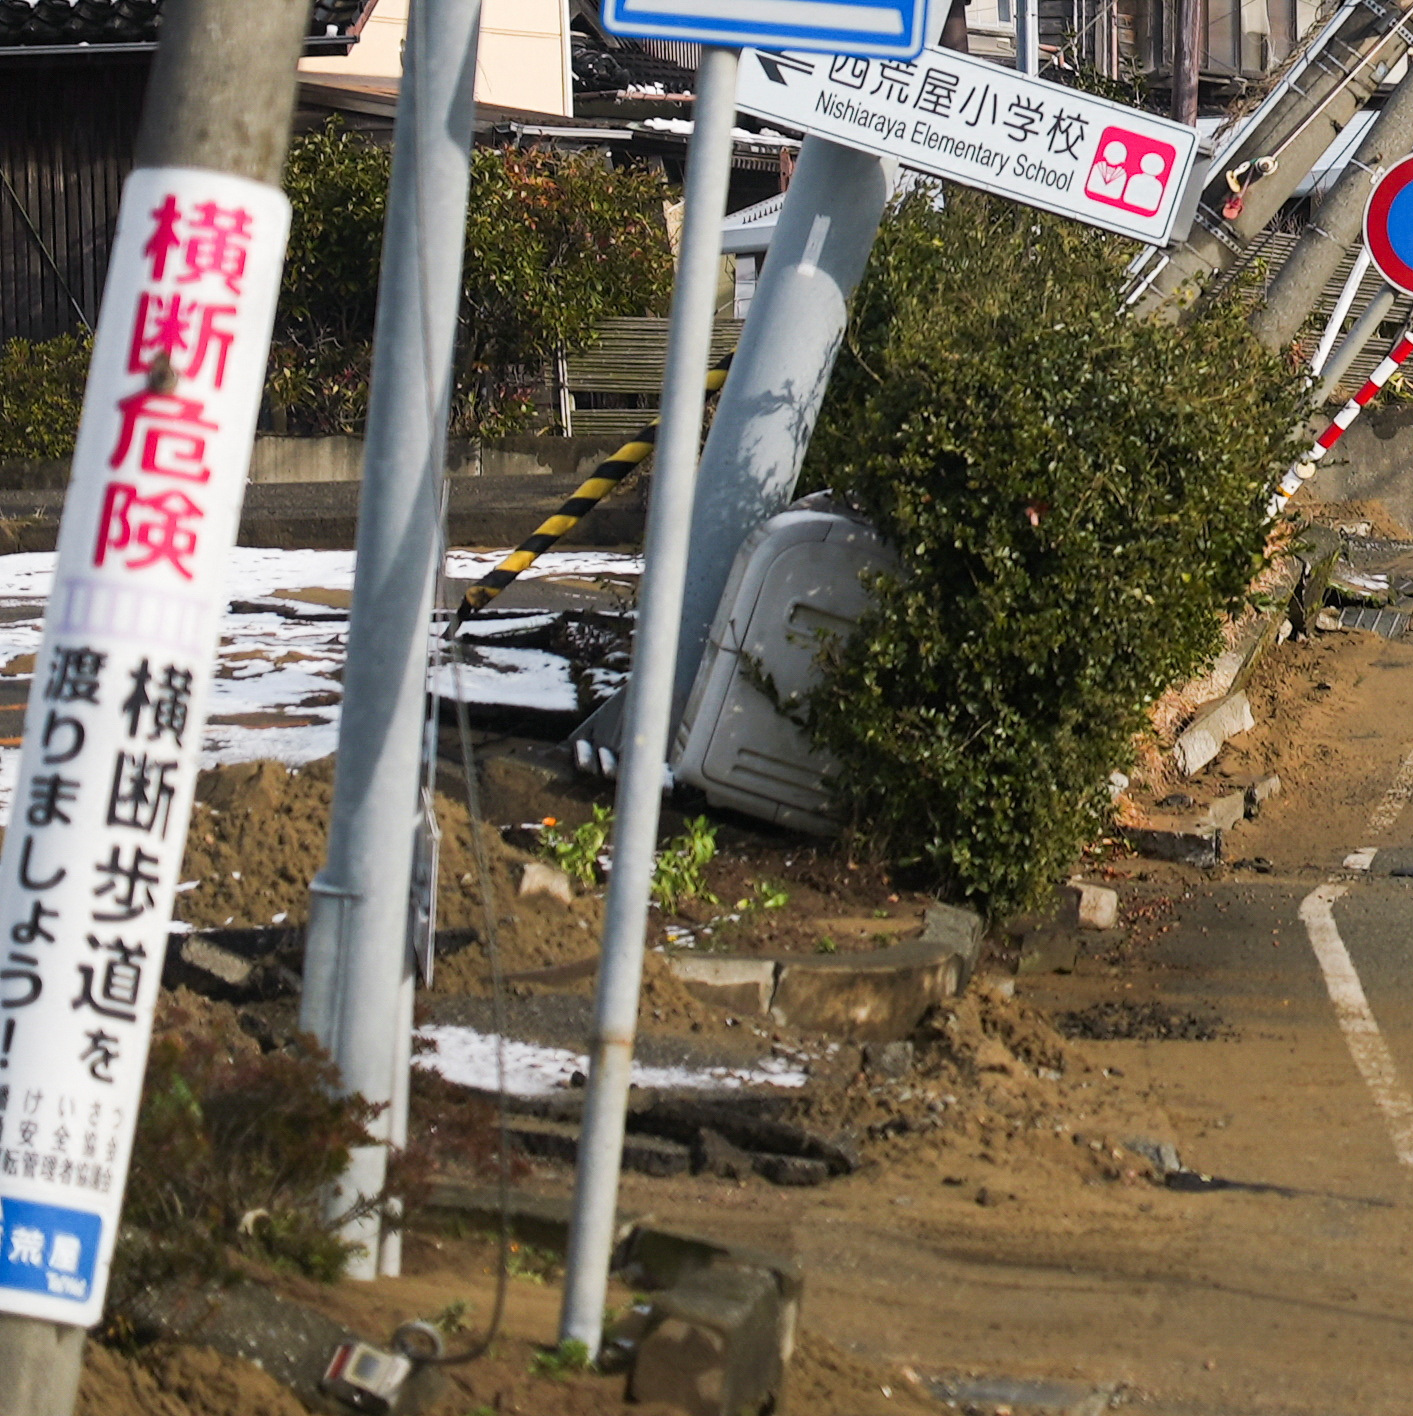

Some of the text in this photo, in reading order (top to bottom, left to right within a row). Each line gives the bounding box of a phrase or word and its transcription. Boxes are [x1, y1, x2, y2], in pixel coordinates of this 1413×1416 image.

[815, 90, 1075, 193] Nishiaraya Elementary School
[92, 193, 254, 582] 横断危険
[71, 658, 194, 1084] 横断歩道を
